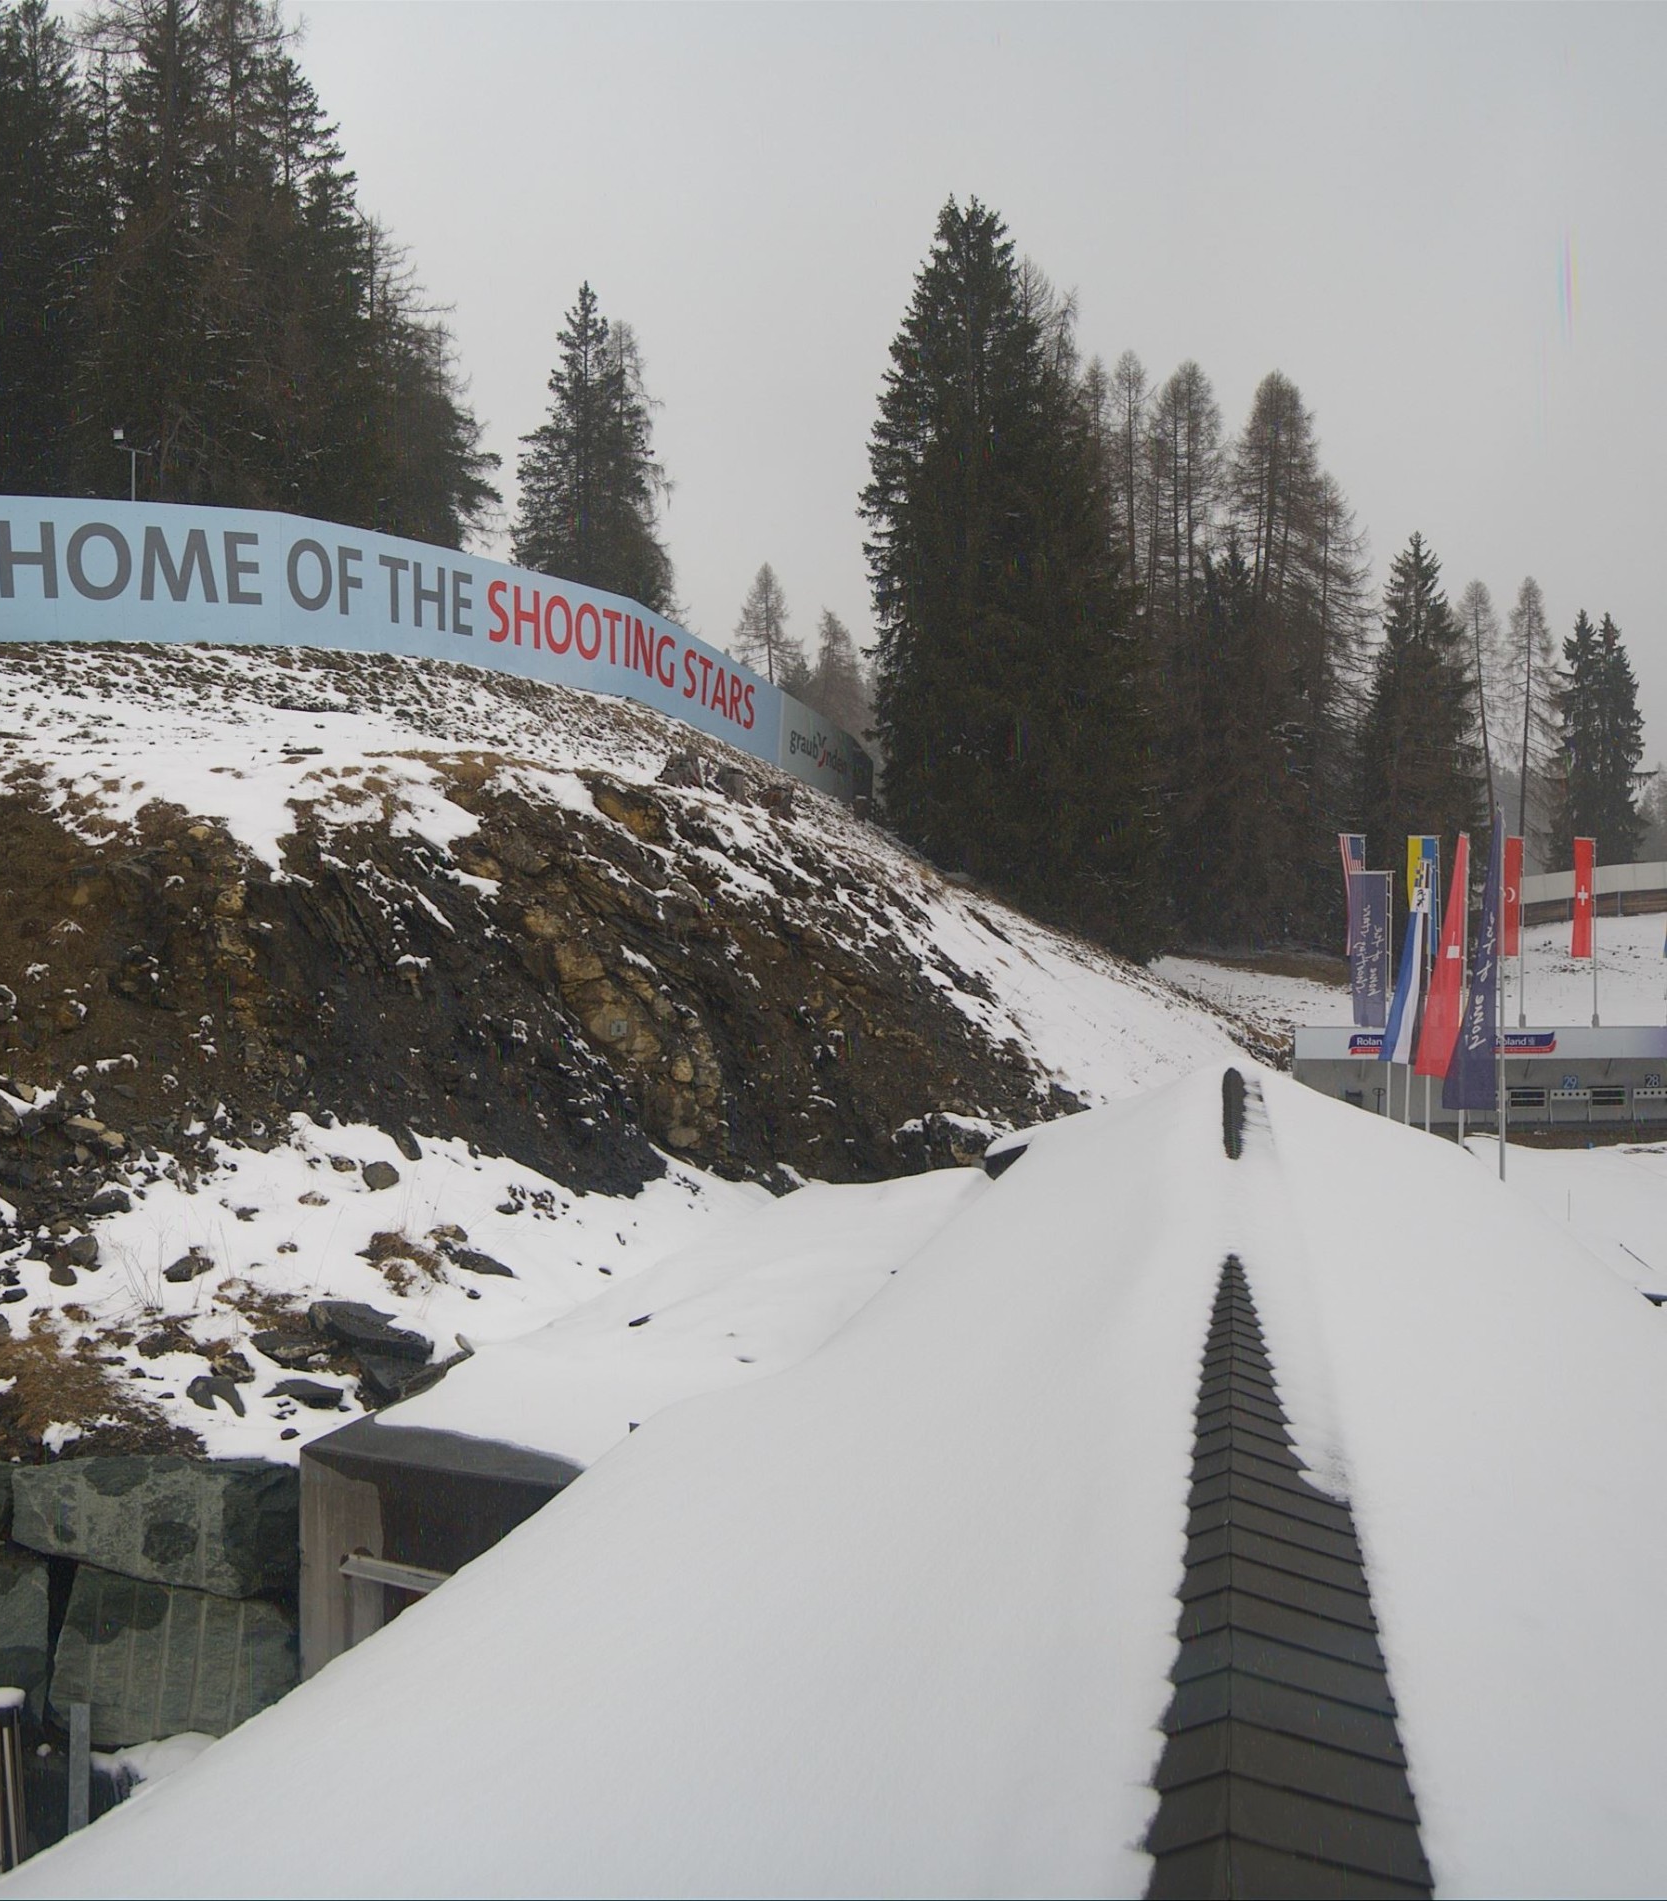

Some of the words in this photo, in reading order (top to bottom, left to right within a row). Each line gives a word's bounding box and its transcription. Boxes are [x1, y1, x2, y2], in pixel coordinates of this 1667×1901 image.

[286, 537, 363, 616] OF
[378, 553, 473, 637] THE
[487, 579, 676, 688] SHOOTING
[682, 648, 756, 731] STARS
[1356, 1037, 1383, 1046] Rolan
[1563, 1076, 1577, 1088] 29
[1646, 1075, 1659, 1087] 28
